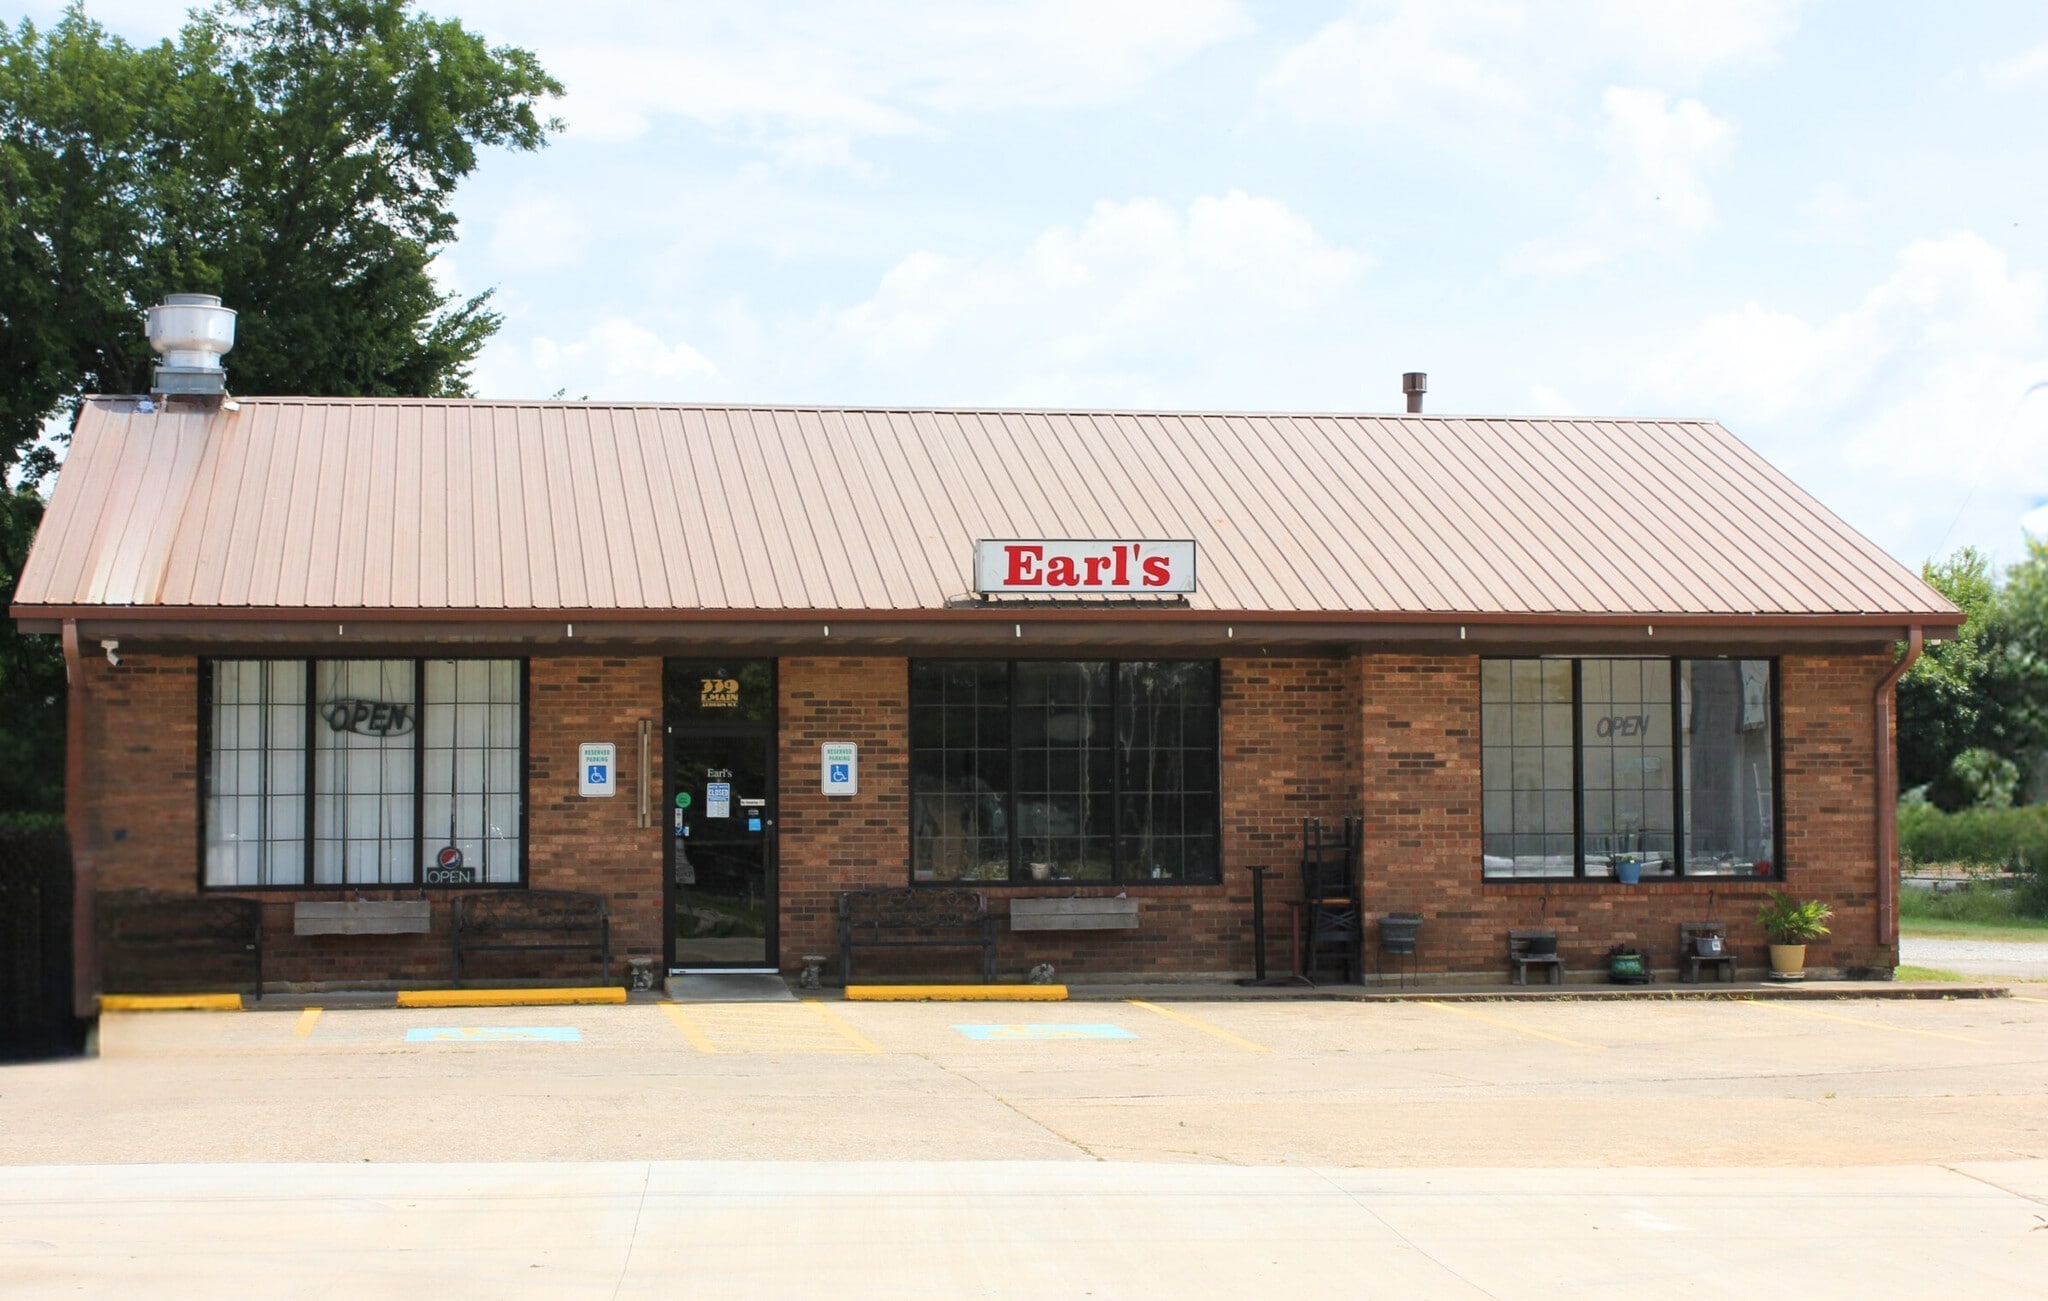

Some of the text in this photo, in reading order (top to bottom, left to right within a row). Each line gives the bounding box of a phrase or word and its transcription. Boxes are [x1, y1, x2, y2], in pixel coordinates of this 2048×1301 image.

[1003, 543, 1171, 587] Earl's
[701, 679, 739, 694] 339
[329, 699, 408, 732] OPEN
[1597, 714, 1650, 737] OPEN
[707, 768, 733, 778] Earl's
[428, 870, 470, 884] OPEN
